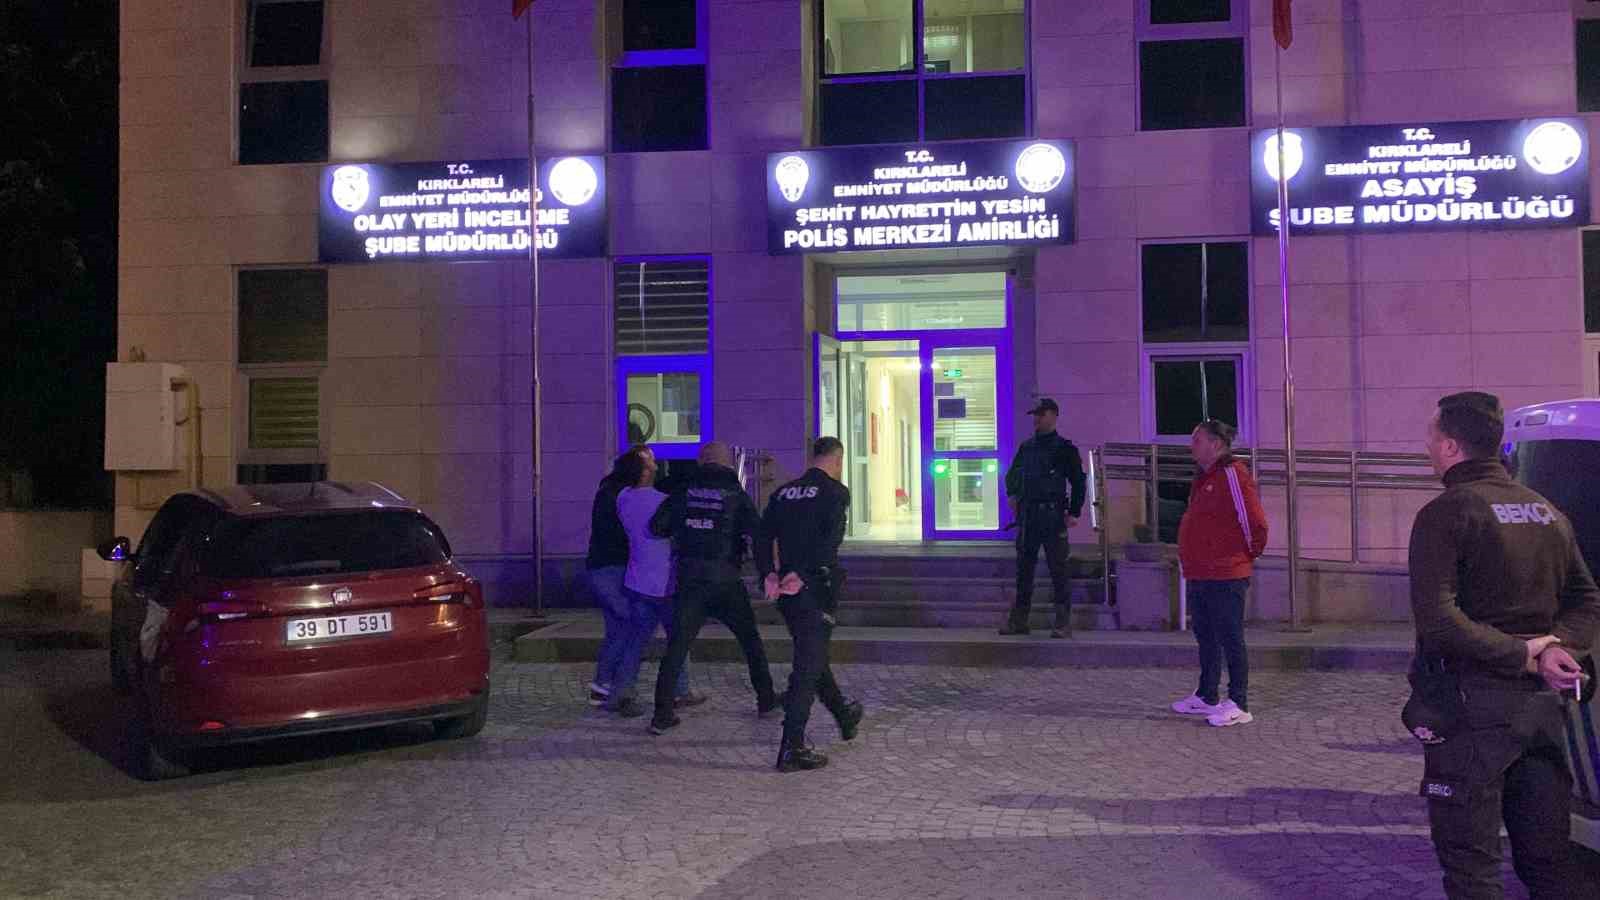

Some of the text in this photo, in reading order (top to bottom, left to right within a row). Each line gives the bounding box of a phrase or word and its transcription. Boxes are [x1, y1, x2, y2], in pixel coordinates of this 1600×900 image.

[1402, 128, 1436, 141] T.C.
[905, 150, 934, 162] T.C.
[447, 164, 474, 175] T.C.
[833, 175, 1009, 197] EMNİYET MÜDÜRLÜĞÜ
[1360, 173, 1477, 200] ASAYİŞ
[354, 208, 570, 231] OLAY YERİ İNCELEME
[795, 195, 1046, 225] ŞEHİT HAYRETTİN YESİN
[1363, 195, 1574, 224] MÜDÜRLÜĞÜ
[784, 214, 1060, 248] POLİS MERKEZİ AMİRLİĞİ
[365, 235, 420, 258] ŞUBE
[296, 613, 389, 638] 39 DT 591
